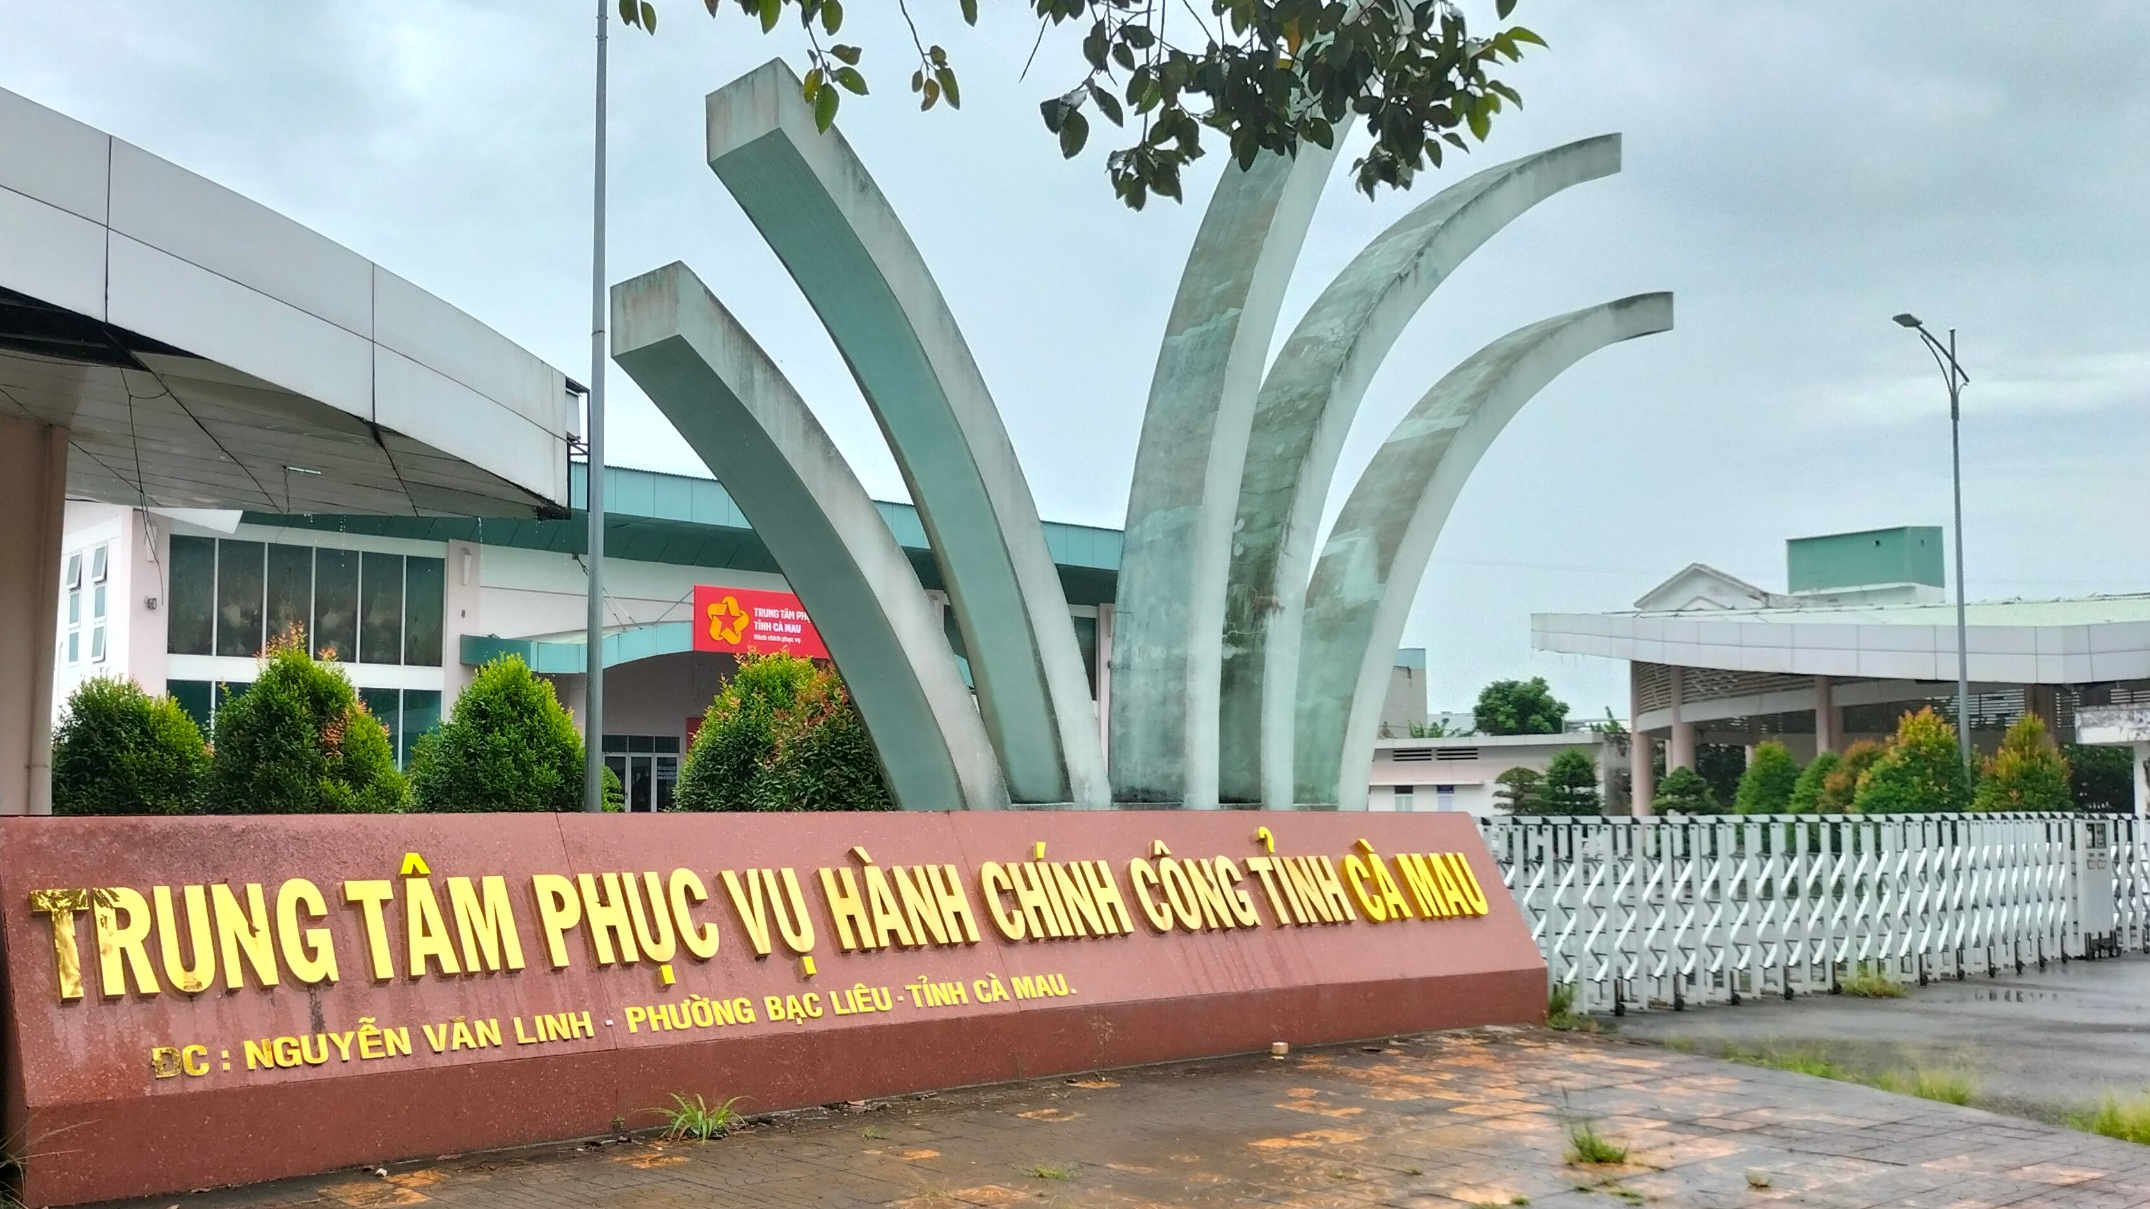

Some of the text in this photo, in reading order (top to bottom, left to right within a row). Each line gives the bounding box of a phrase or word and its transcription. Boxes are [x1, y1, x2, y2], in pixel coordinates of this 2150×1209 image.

[753, 607, 780, 618] TRUNG
[780, 608, 795, 620] TÂM
[753, 619, 801, 634] TỈNH CÀ MAU
[30, 826, 1489, 1000] TRUNG TÂM PHỤC VỤ HÀNH CHÍNH CÔNG TỈNH CÀ MAU
[243, 1016, 412, 1070] NGUYỄN
[422, 1016, 502, 1053] VĂN
[513, 1010, 595, 1044] LINH
[624, 993, 756, 1034] PHƯỜNG
[765, 991, 824, 1026] BẠC
[972, 972, 1010, 1003] CÀ
